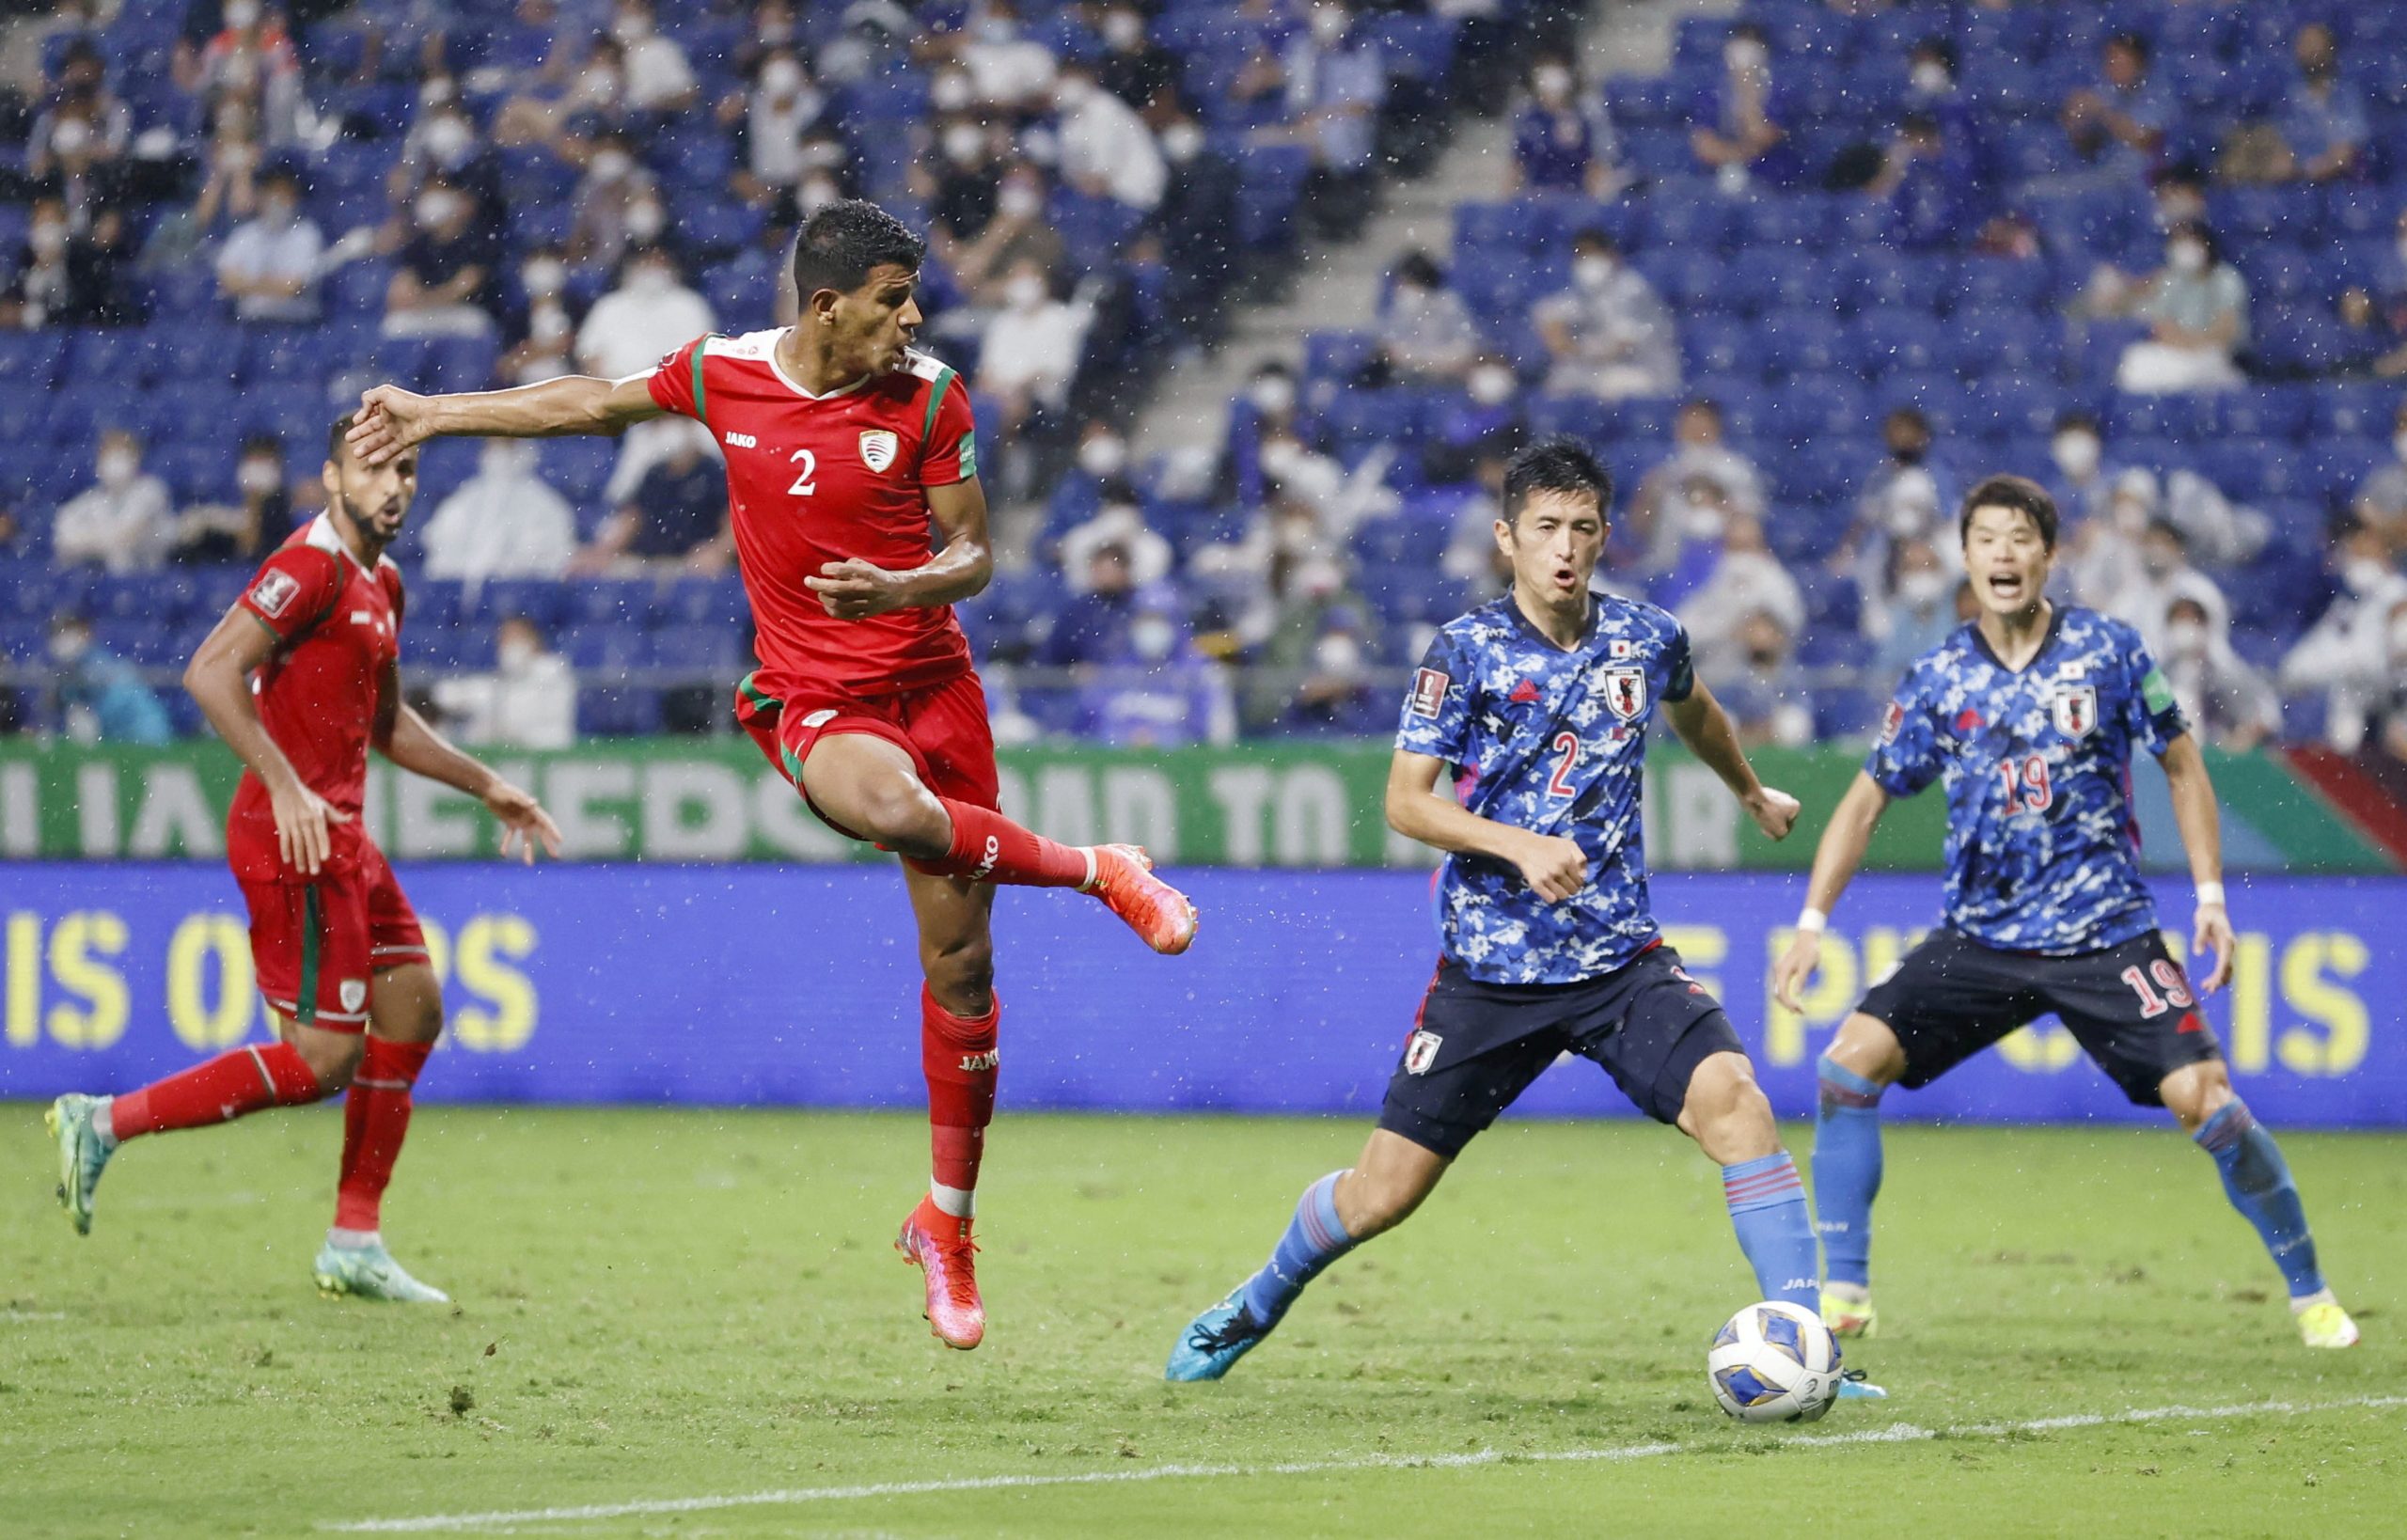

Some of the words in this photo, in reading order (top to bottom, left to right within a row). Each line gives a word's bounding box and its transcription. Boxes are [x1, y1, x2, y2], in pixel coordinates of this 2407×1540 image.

[725, 431, 757, 448] JAKO
[787, 448, 816, 496] 2
[1548, 731, 1580, 797] 2
[1999, 754, 2053, 817] 19
[1209, 761, 1348, 864] TO
[5, 910, 130, 1047] IS
[2120, 959, 2193, 1019] 19
[2231, 930, 2370, 1075] IS
